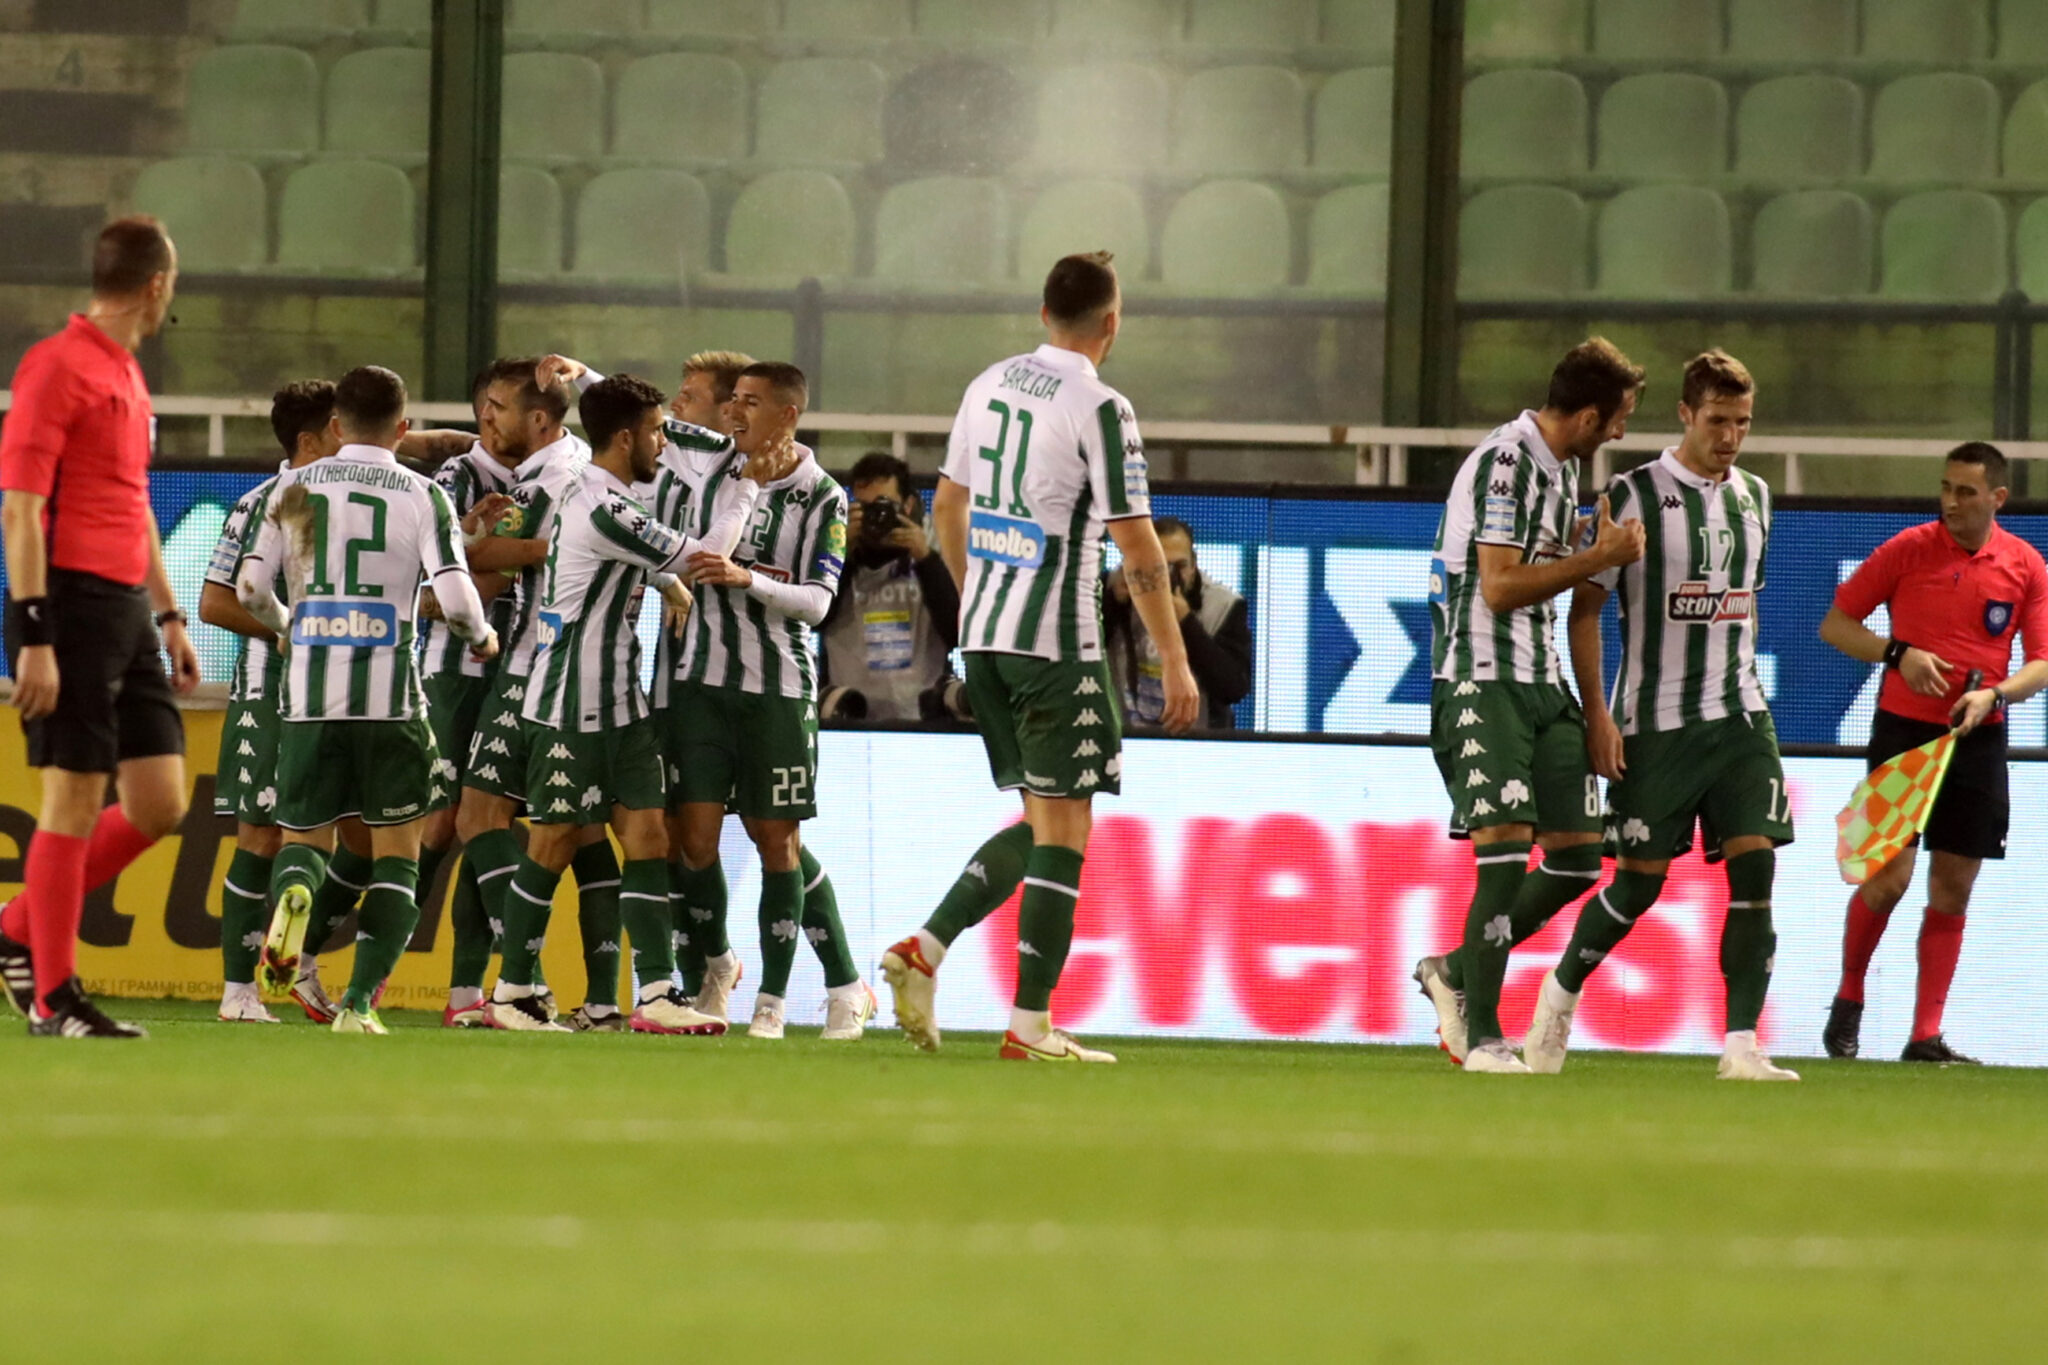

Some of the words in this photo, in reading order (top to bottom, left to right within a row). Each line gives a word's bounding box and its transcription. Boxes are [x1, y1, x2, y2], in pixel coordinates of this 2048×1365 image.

[974, 398, 1033, 519] 31
[305, 491, 388, 597] 12
[971, 527, 1038, 559] molto
[1699, 527, 1735, 574] 17
[301, 610, 388, 638] molto
[771, 767, 807, 806] 22
[1584, 773, 1599, 817] 8
